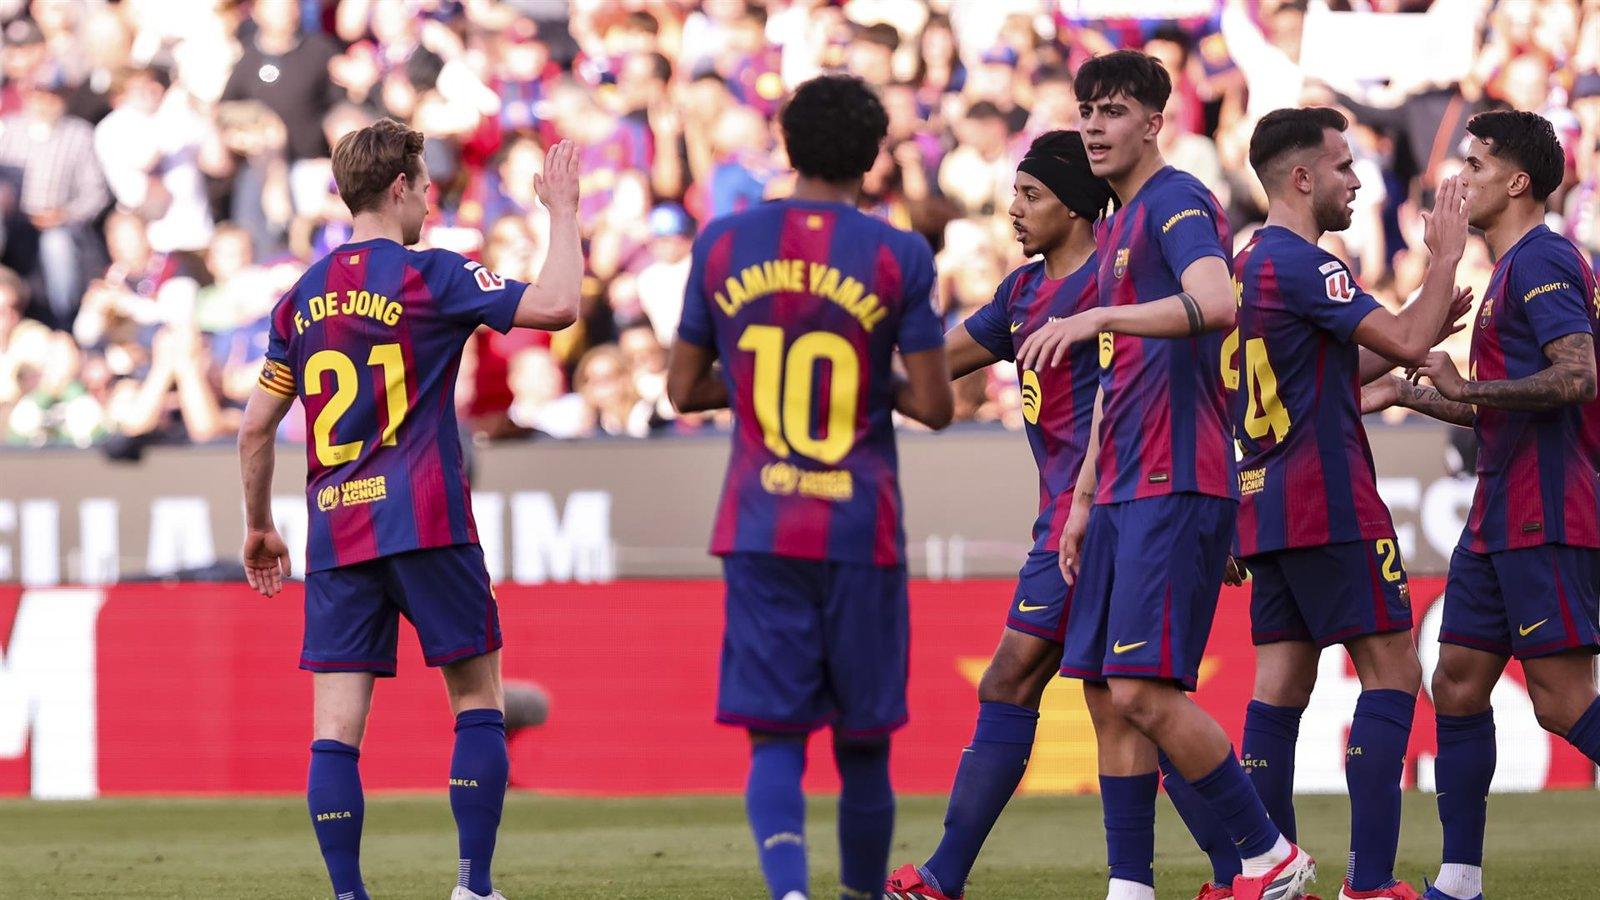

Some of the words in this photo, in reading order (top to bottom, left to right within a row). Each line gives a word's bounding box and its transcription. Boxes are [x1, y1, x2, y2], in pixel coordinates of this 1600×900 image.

[1162, 209, 1201, 233] AMBILIGHT
[294, 310, 311, 335] F.
[308, 291, 339, 322] DE
[341, 290, 403, 326] JONG
[714, 259, 804, 318] LAMINE
[809, 261, 888, 333] YAMAL
[1523, 282, 1561, 303] AMBILIGHT
[304, 343, 408, 466] 21
[737, 324, 859, 464] 10
[341, 475, 386, 492] UNHCR
[342, 485, 387, 503] ACNUR
[1375, 538, 1407, 582] 2
